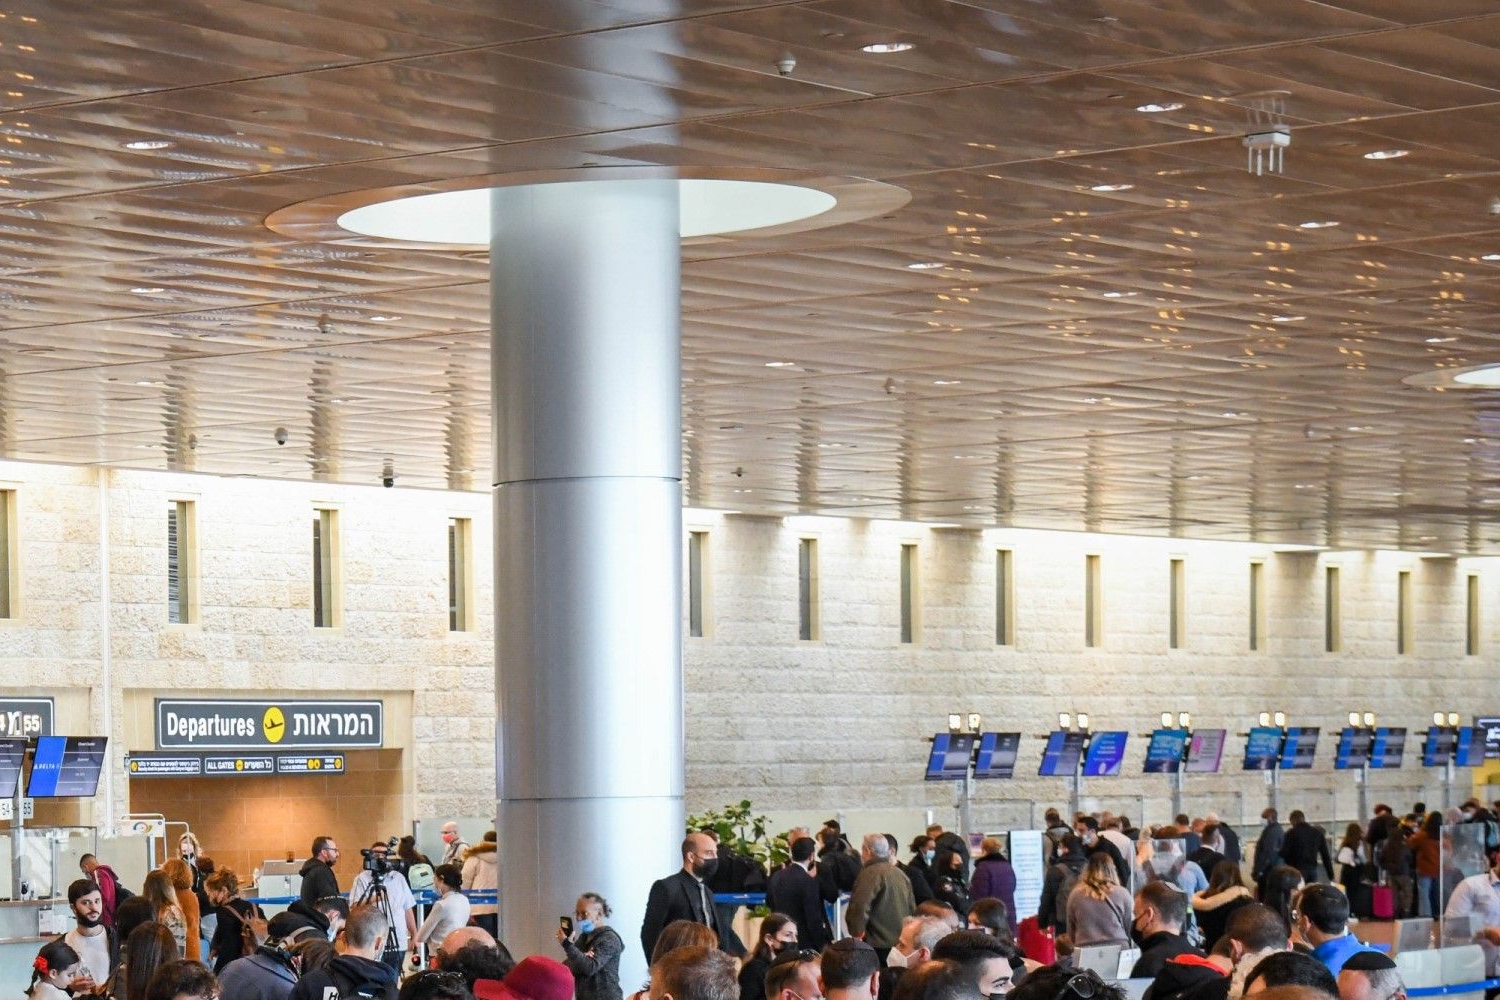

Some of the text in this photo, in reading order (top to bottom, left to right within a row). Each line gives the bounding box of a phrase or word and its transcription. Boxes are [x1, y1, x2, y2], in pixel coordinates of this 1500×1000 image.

[23, 713, 41, 732] 55
[167, 712, 255, 742] Departures
[292, 712, 374, 736] המראות
[207, 761, 217, 770] ALL
[217, 760, 235, 770] GATES
[1, 803, 11, 816] 54
[23, 801, 32, 815] 55
